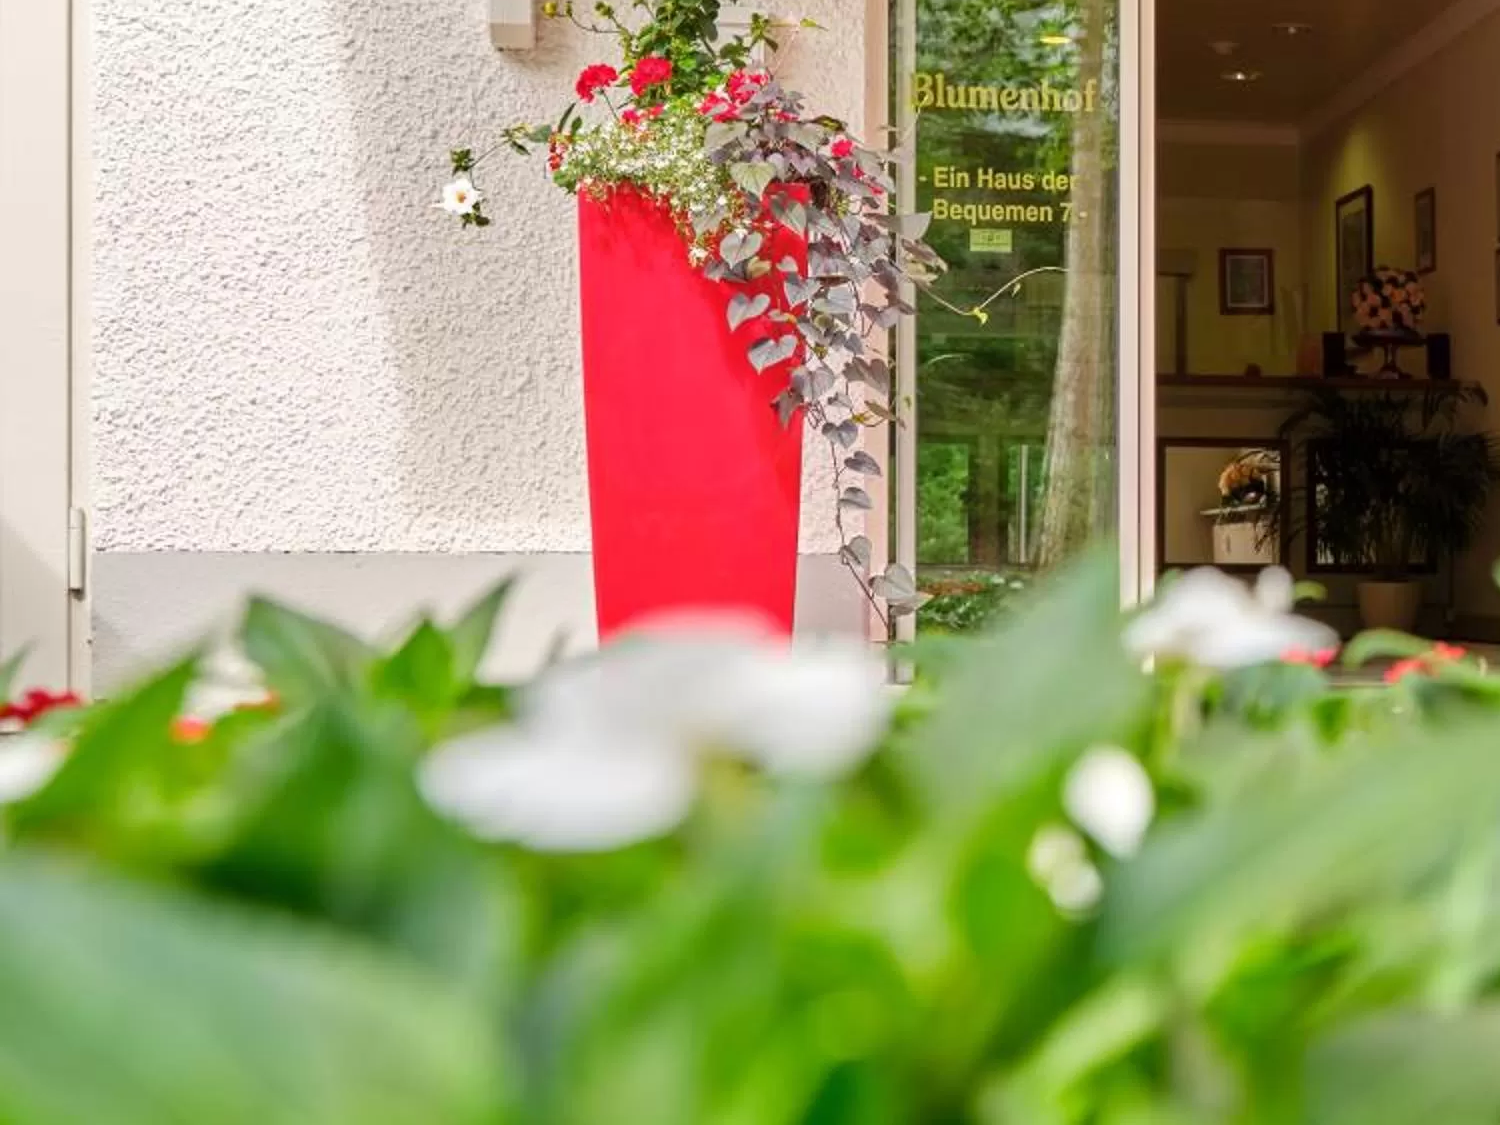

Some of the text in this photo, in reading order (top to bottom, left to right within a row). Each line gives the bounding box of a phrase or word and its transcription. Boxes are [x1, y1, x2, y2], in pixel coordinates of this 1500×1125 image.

[911, 72, 1097, 113] Blumenhof
[933, 166, 970, 188] Ein
[977, 168, 1035, 190] Haus
[933, 198, 1053, 225] Bequemen
